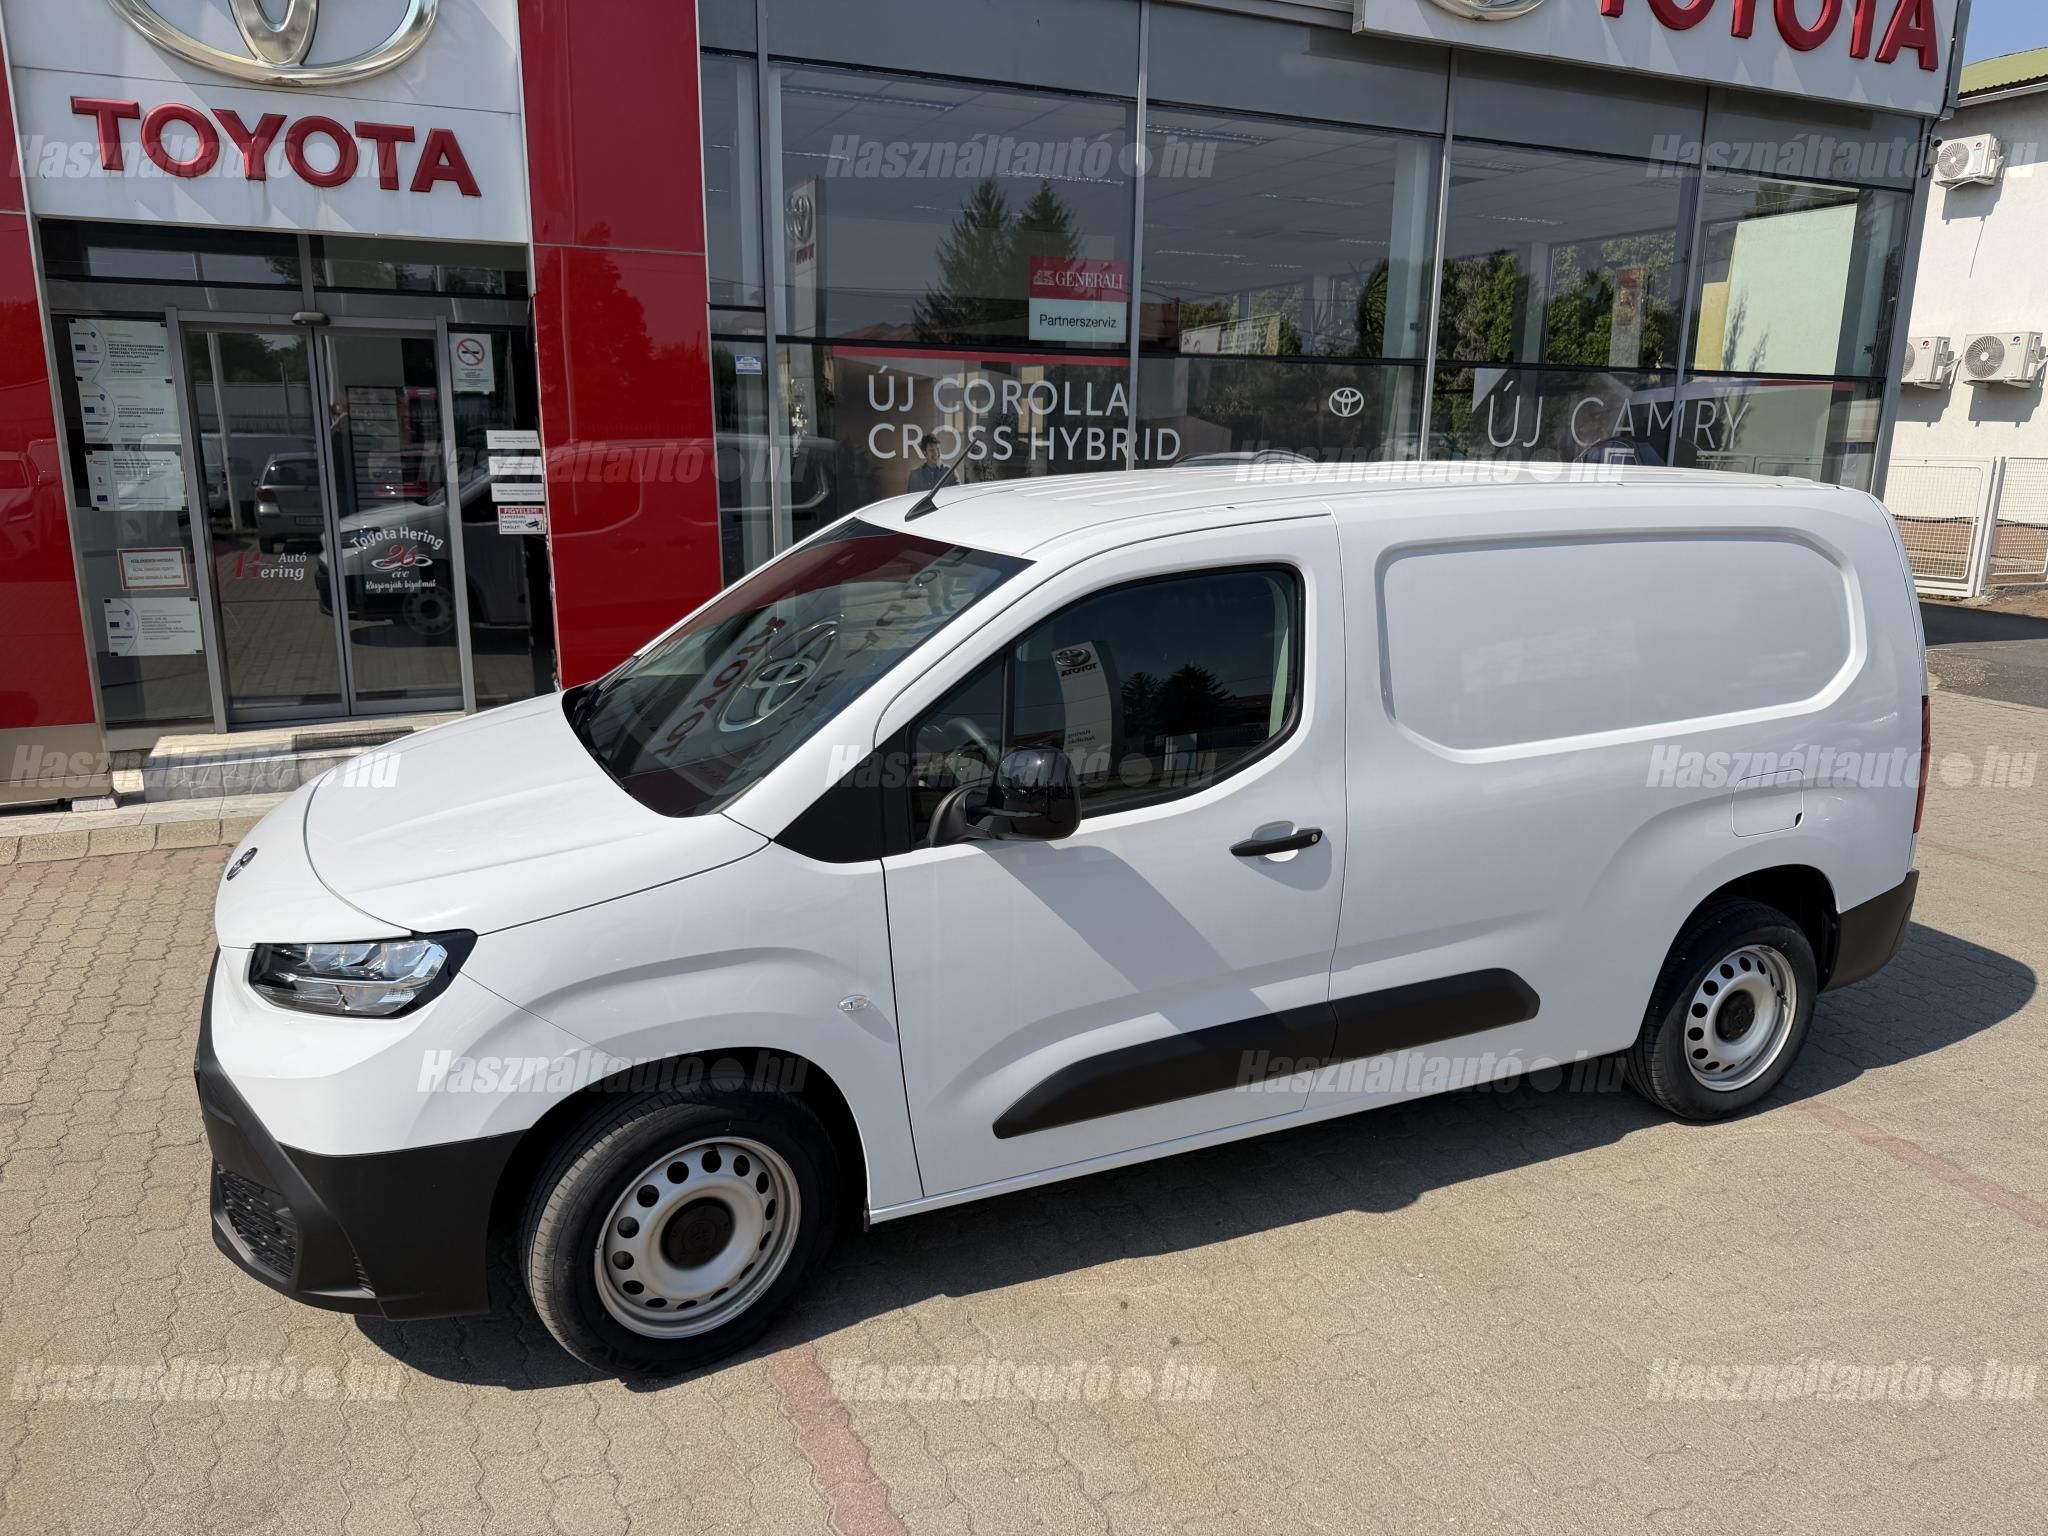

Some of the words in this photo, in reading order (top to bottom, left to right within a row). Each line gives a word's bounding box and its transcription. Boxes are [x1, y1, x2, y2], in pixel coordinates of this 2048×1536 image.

[71, 96, 481, 197] TOYOTA
[1055, 271, 1123, 289] GENERALI
[1039, 313, 1117, 329] Partnerszerviz
[868, 365, 914, 412] ÚJ
[933, 377, 1129, 416] COROLLA
[1487, 380, 1543, 448] ÚJ
[1571, 396, 1749, 449] CAMRY
[868, 423, 1013, 460] CROSS
[1032, 426, 1181, 461] HYBRID
[350, 529, 397, 549] Toyota
[400, 526, 444, 550] Hering
[278, 551, 307, 563] Autó
